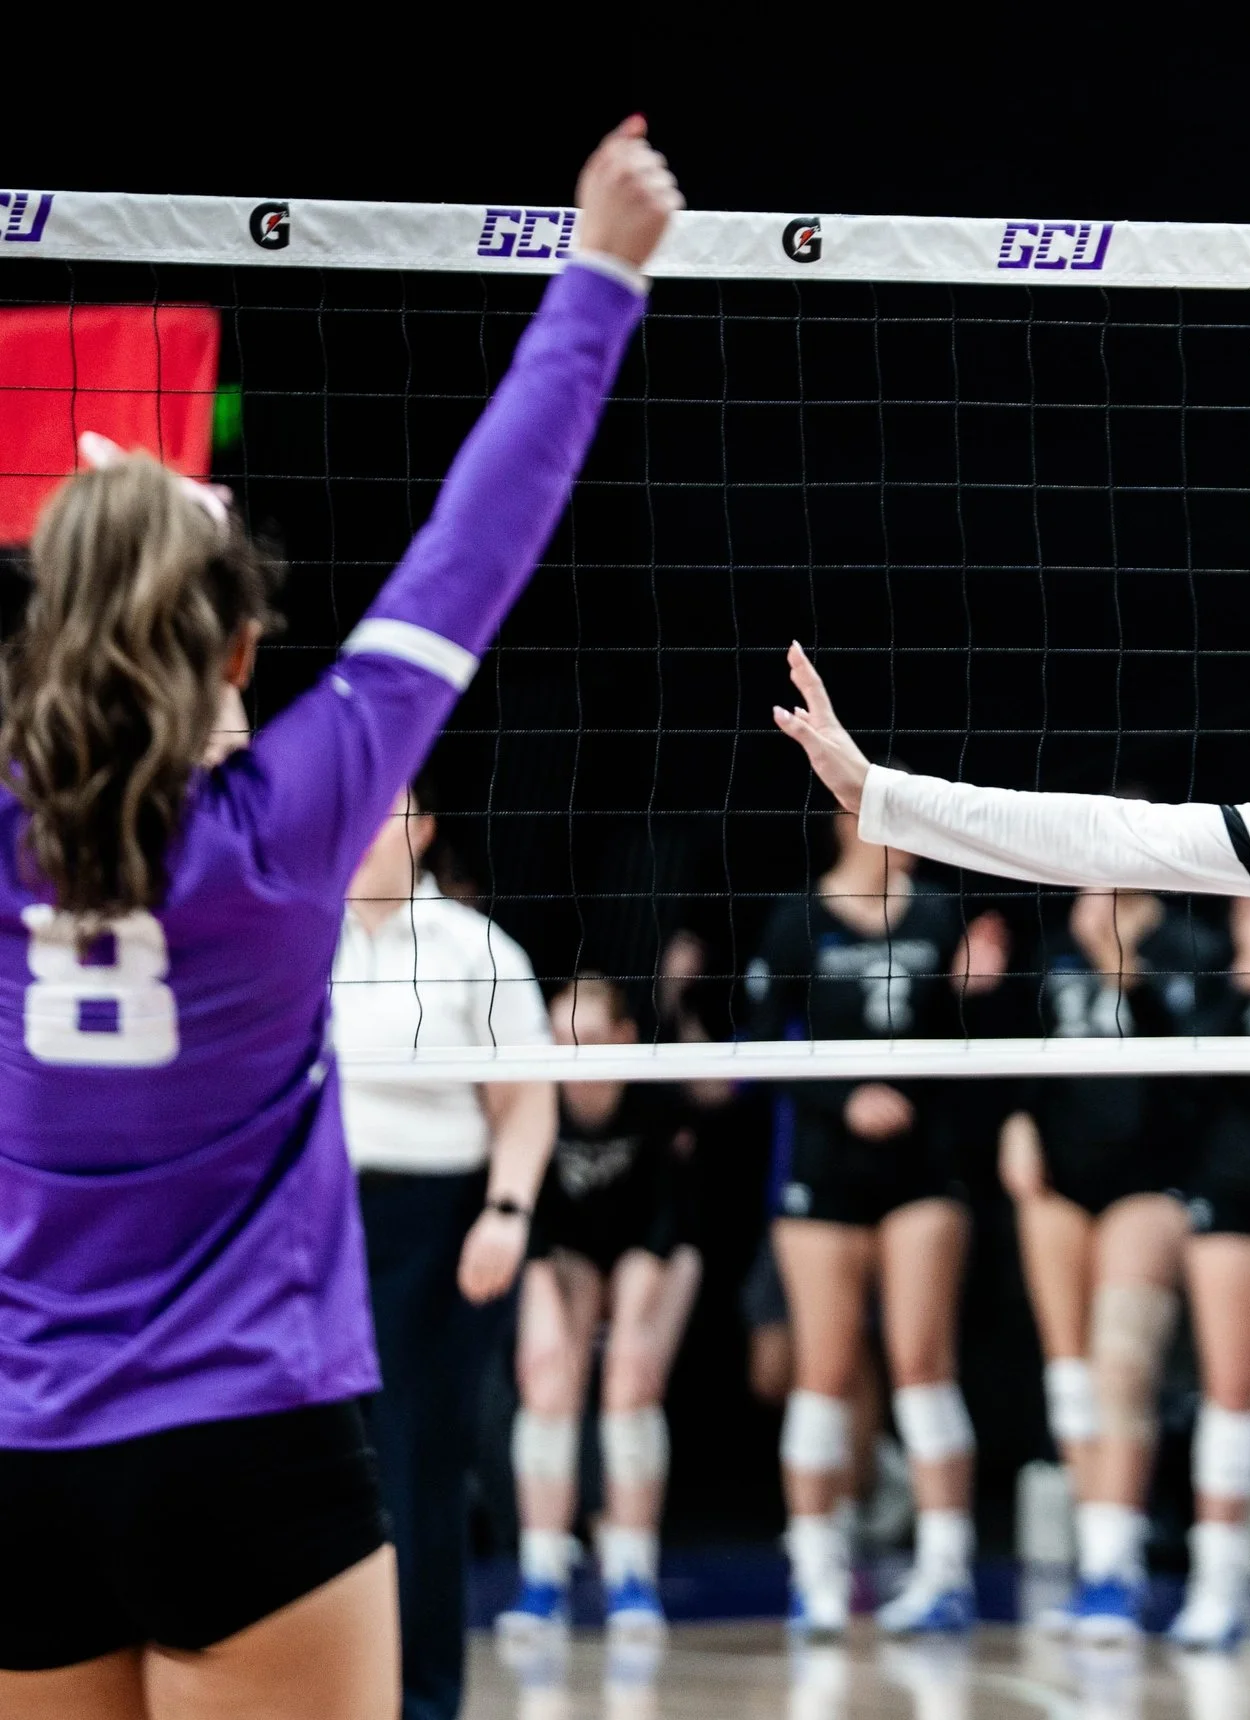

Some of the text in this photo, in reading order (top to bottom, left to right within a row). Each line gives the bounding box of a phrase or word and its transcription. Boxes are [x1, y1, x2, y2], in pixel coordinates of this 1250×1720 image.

[0, 192, 55, 242] U
[998, 221, 1114, 270] GCU
[23, 906, 180, 1067] 8
